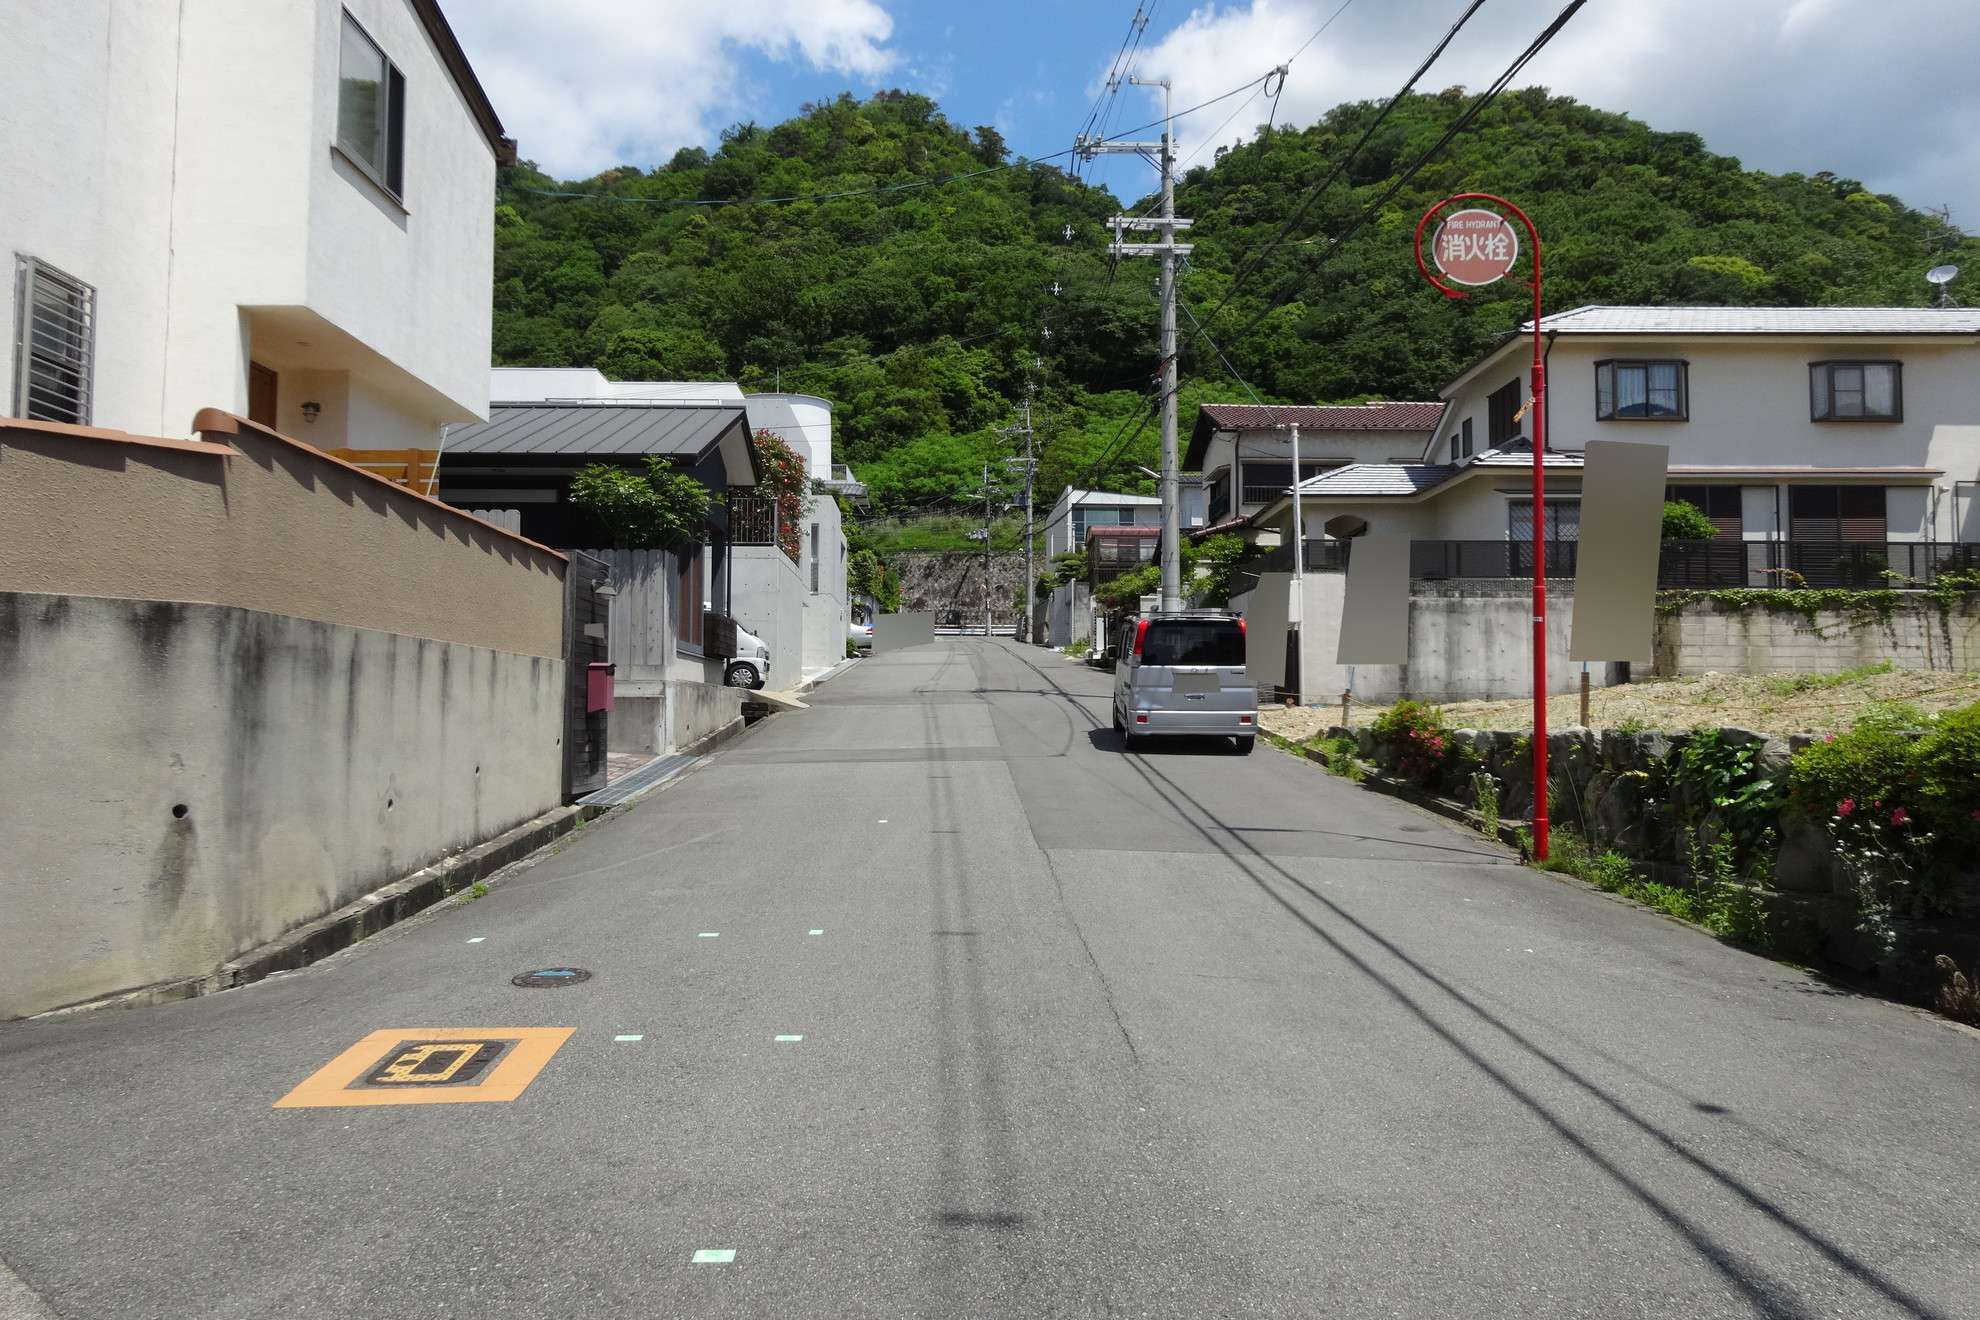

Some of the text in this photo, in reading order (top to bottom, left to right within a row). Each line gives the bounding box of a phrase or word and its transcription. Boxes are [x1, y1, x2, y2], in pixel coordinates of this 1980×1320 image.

[1447, 220, 1500, 229] FIRE HYDRANT
[1441, 233, 1509, 262] 消火栓
